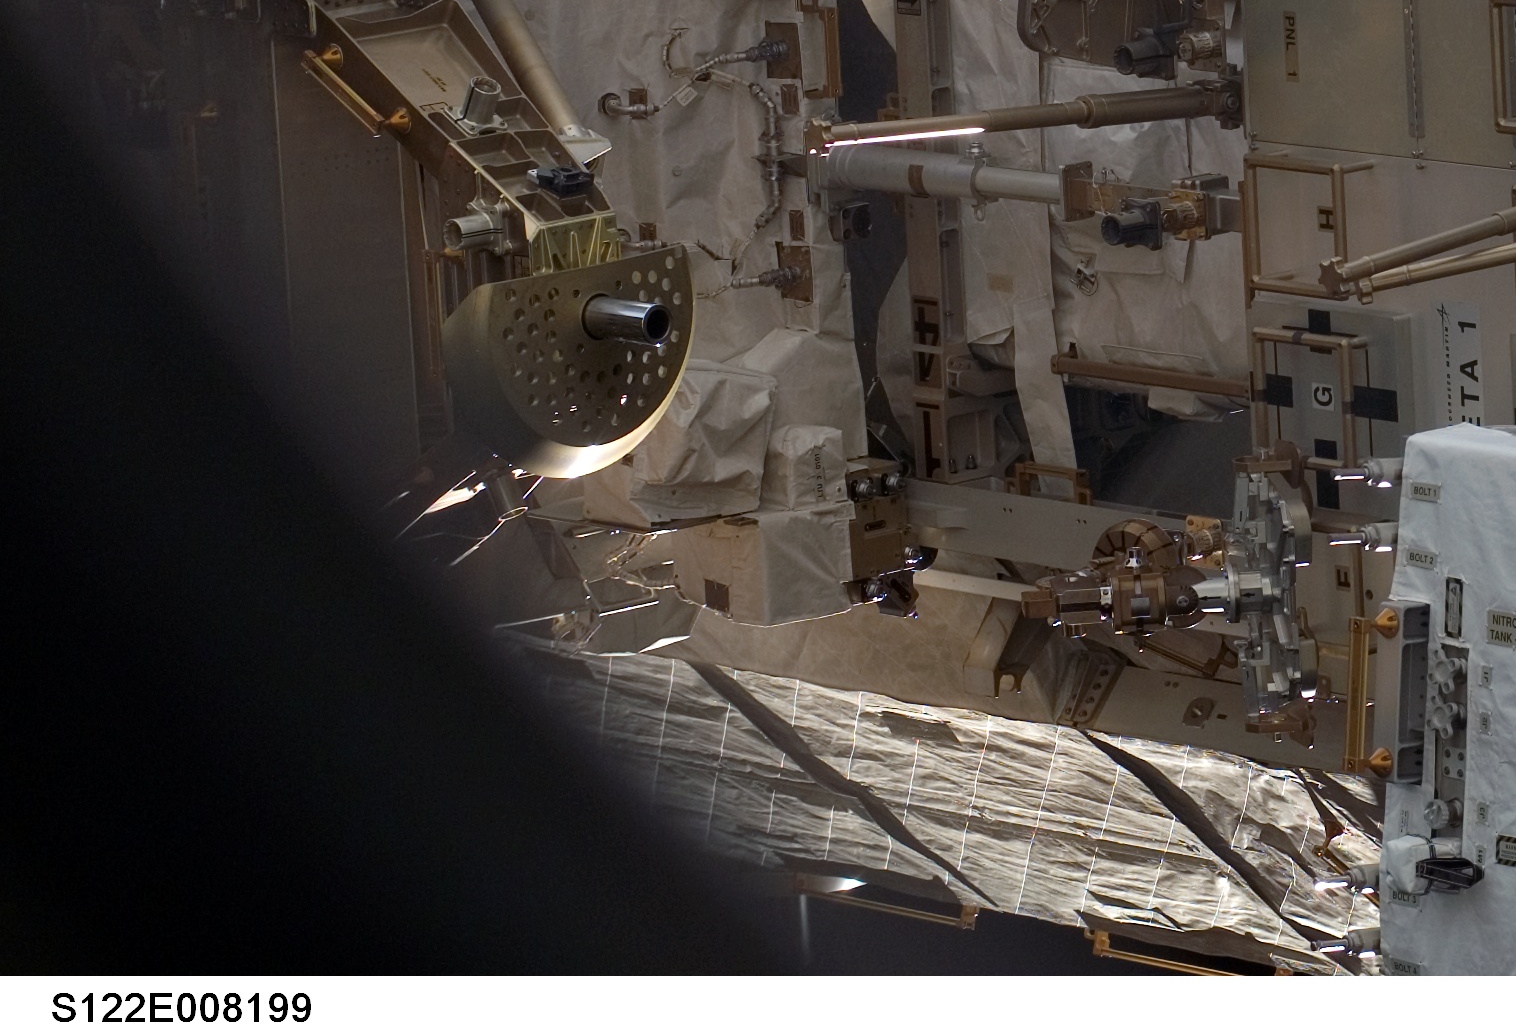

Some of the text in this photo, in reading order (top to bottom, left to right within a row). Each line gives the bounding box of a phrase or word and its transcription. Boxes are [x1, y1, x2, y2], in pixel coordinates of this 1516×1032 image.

[1285, 15, 1296, 51] PNL
[1319, 209, 1334, 230] H
[1457, 320, 1481, 426] ETA 1
[1312, 384, 1333, 409] G
[1413, 485, 1431, 498] BOLT
[1409, 551, 1427, 564] BOLT
[1336, 568, 1351, 588] F
[1490, 630, 1513, 644] TANK
[1393, 961, 1412, 974] BOLT
